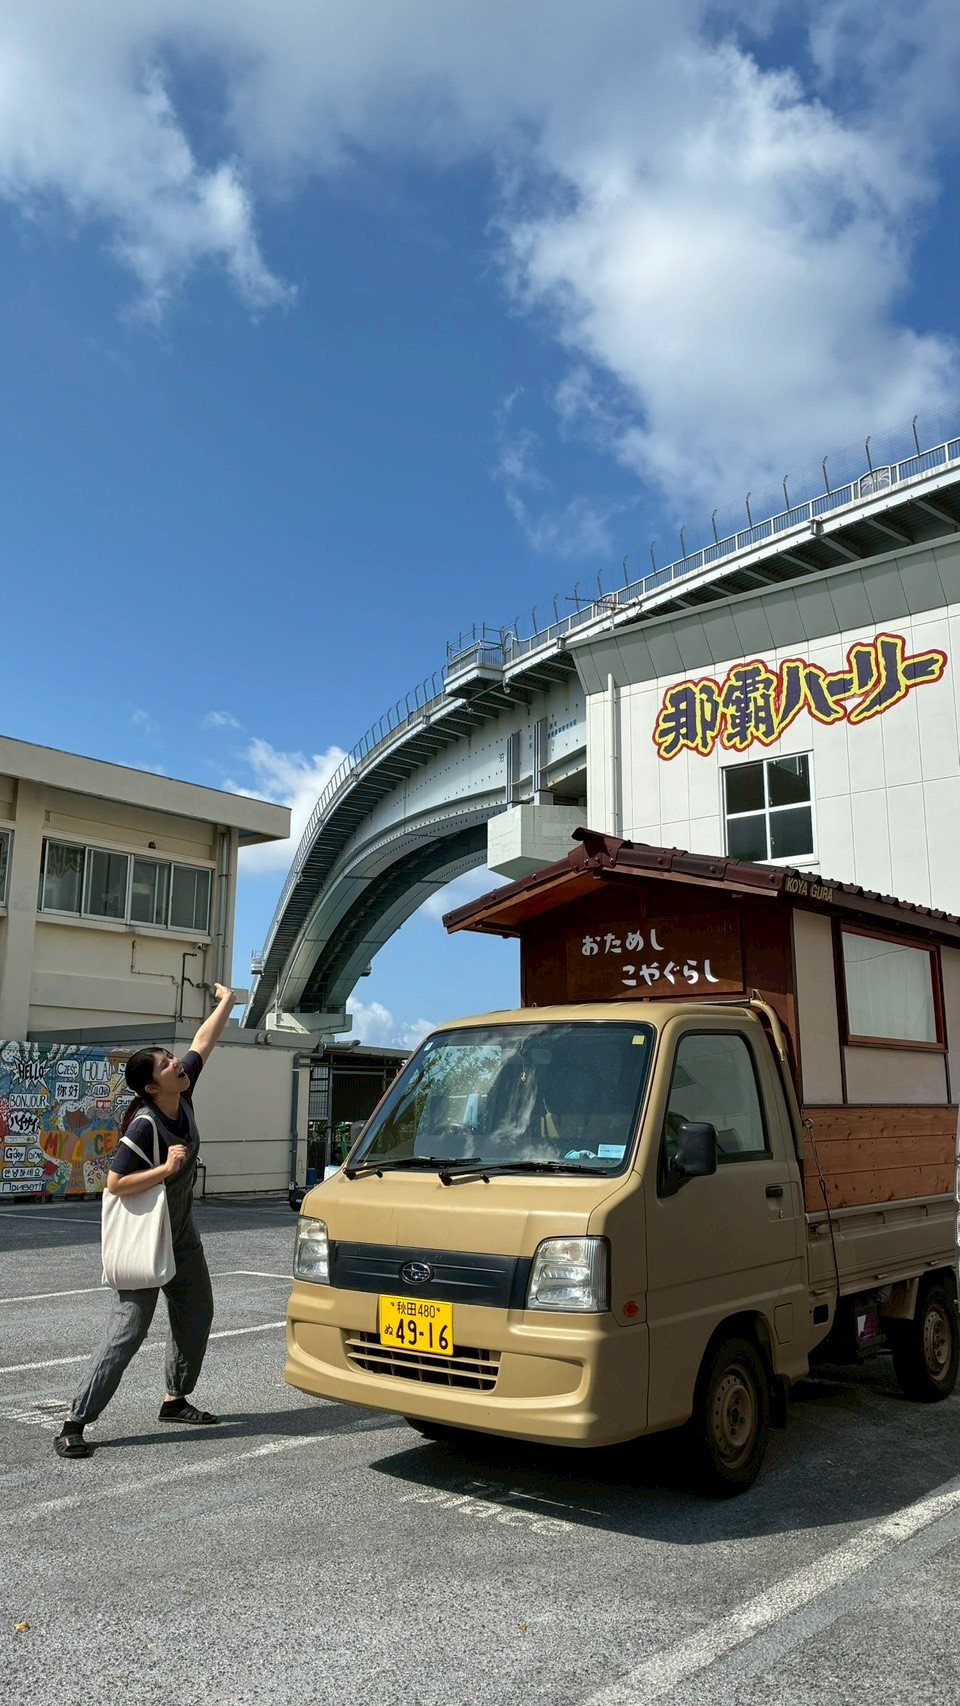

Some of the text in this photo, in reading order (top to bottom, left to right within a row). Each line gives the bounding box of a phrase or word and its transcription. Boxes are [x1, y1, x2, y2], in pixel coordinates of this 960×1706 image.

[785, 877, 833, 903] KOYA GURA
[581, 928, 665, 956] おためし
[621, 958, 720, 987] こやぐらし
[18, 1061, 44, 1080] HELLO
[57, 1084, 79, 1098] 你好
[9, 1094, 46, 1108] BONJOUR
[10, 1114, 38, 1133] ハイサイ
[4, 1168, 40, 1178] 안녕하세요
[384, 1318, 448, 1350] ぬ 49-16
